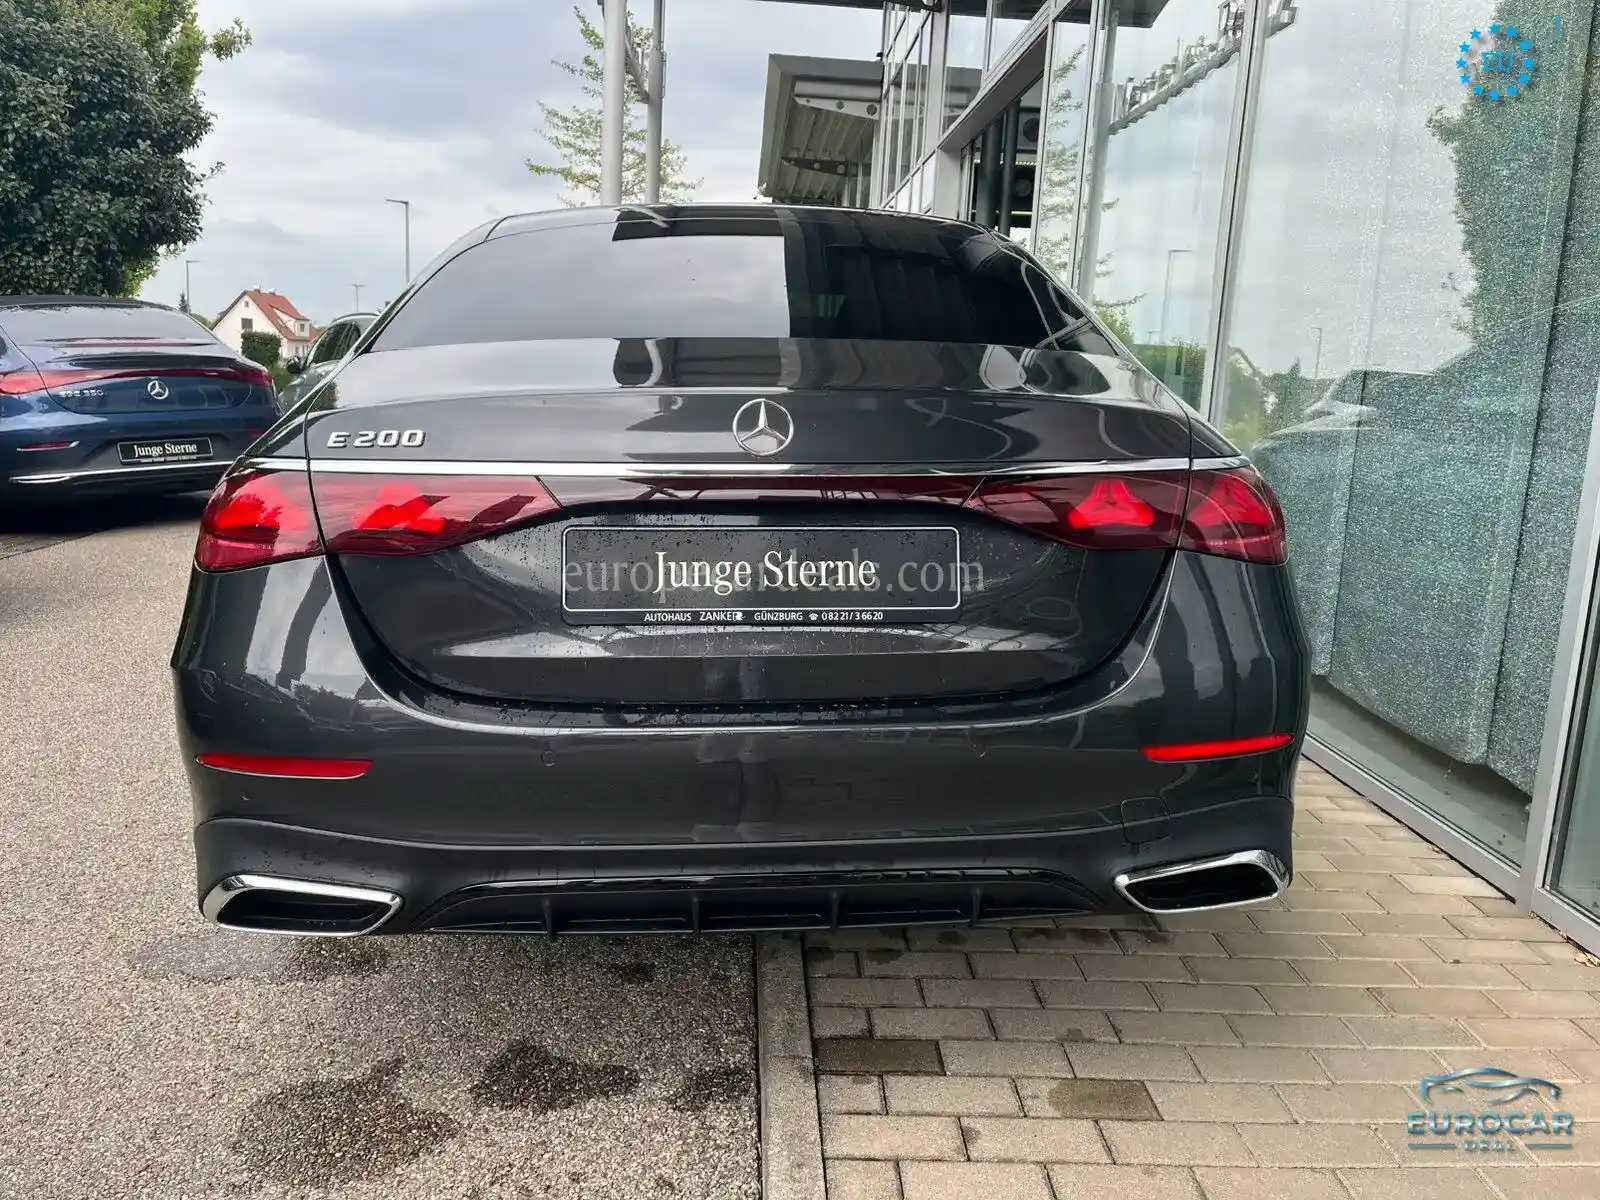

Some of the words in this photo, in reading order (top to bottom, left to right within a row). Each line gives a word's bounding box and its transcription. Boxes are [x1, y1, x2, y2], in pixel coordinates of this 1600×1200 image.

[326, 431, 351, 449] E
[352, 429, 426, 448] 200
[133, 445, 163, 458] Junge
[164, 443, 198, 454] Sterne
[653, 551, 752, 596] Junge
[763, 550, 876, 588] Sterne
[644, 612, 692, 622] AUTOHAUS
[754, 611, 803, 621] GÜNZBURG
